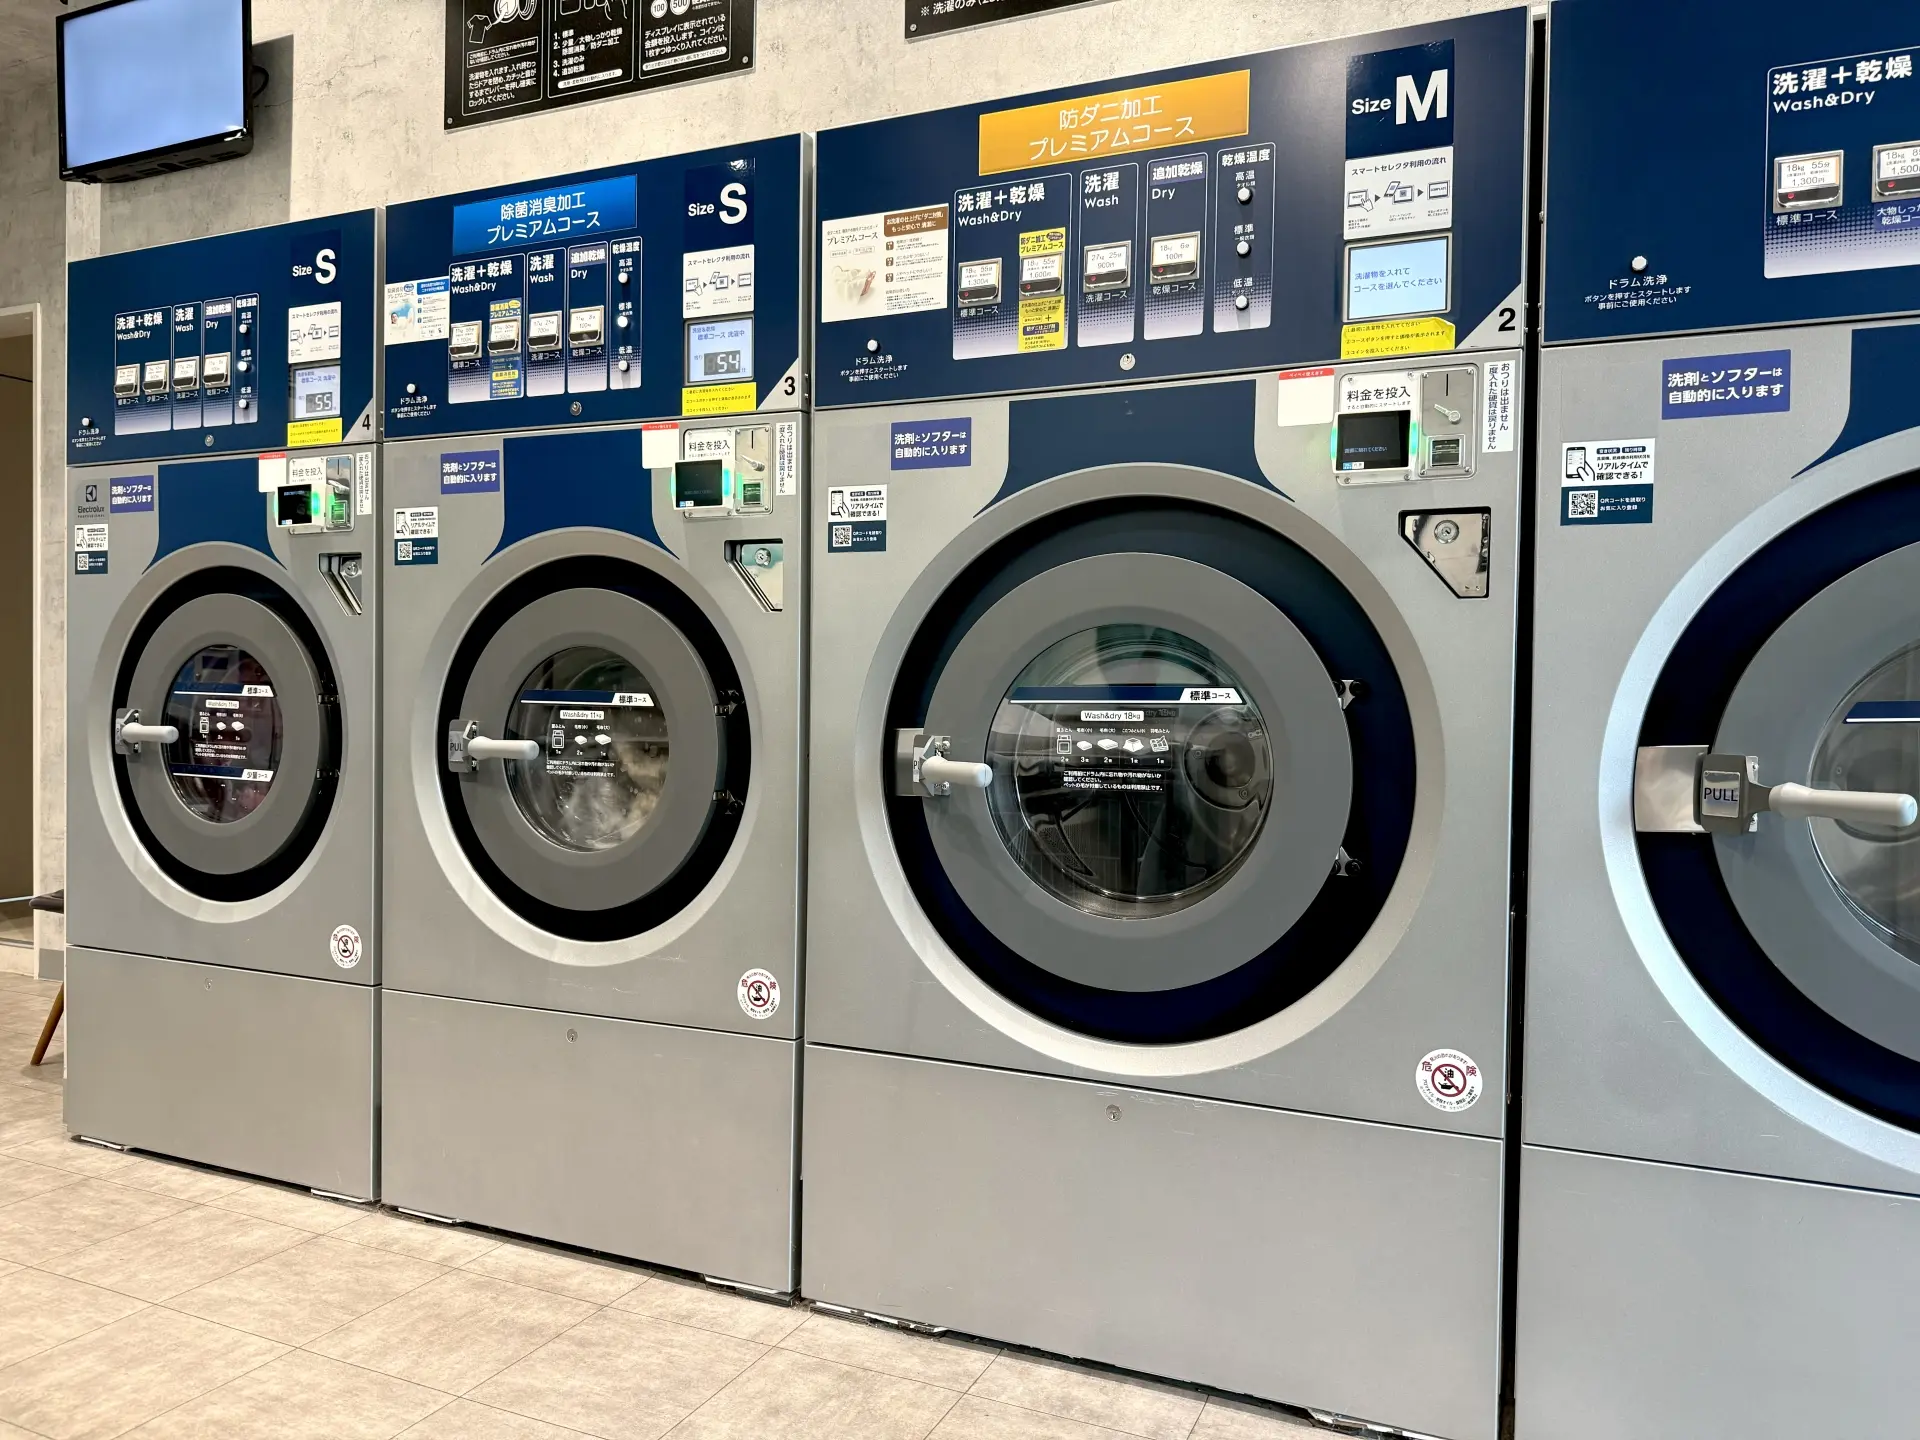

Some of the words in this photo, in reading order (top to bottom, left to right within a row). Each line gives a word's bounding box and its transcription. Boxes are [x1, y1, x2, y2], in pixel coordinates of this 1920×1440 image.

[654, 4, 664, 12] 100
[645, 14, 726, 39] ディスプレイに表示されている
[645, 24, 724, 49] 金額を投入します。コインは
[646, 34, 727, 58] 1枚ずつゆっくり入れてください。
[562, 55, 584, 66] 洗濯のみ
[469, 62, 536, 81] 洗濯物を入れます。入れ終わっ
[1773, 55, 1912, 95] 洗濯＋乾燥
[469, 68, 536, 90] たらドアを閉め、カチッと音が
[469, 78, 536, 98] するまでレバーを押し確実に
[469, 92, 515, 107] ロックしてください。
[1352, 97, 1391, 115] Size
[1395, 68, 1448, 125] M
[1773, 91, 1875, 113] Wash&Dry
[1059, 95, 1162, 130] 防ダニ加工
[1028, 115, 1195, 161] プレミアムコース
[1222, 148, 1270, 167] 乾燥温度
[1152, 161, 1203, 181] 追加乾燥
[1352, 157, 1446, 176] スマートセレクタ利用の流れ
[1787, 164, 1805, 172] 18kg
[1084, 171, 1120, 194] 洗濯
[1235, 169, 1255, 182] 高温
[1792, 176, 1824, 187] 1,300円
[958, 182, 1045, 213] 洗濯＋乾燥
[1152, 188, 1176, 200] Dry
[501, 192, 586, 221] 除菌消臭加工
[688, 203, 714, 216] Size
[719, 182, 747, 224] S
[1084, 195, 1119, 209] Wash
[958, 210, 1022, 227] Wash&Dry
[1776, 210, 1837, 226] 標準コース
[487, 211, 600, 244] プレミアムコース
[1234, 224, 1254, 235] 標準
[827, 232, 878, 246] プレミアムコース
[1020, 234, 1045, 245] 防ダニ加工
[612, 241, 640, 255] 乾燥温度
[1020, 241, 1064, 253] プレミアムコース
[530, 254, 554, 272] 洗濯
[571, 248, 605, 265] 追加乾燥
[619, 258, 632, 267] 高温
[688, 253, 750, 266] スマートセレクタ利用の流れ
[292, 265, 312, 277] Size
[315, 248, 336, 284] S
[451, 259, 512, 282] 洗濯＋乾燥
[530, 274, 554, 284] Wash
[571, 269, 587, 280] Dry
[1355, 267, 1410, 280] 洗濯物を入れて
[451, 281, 496, 294] Wash&Dry
[1153, 282, 1196, 295] 乾燥コース
[1233, 277, 1253, 288] 低温
[1354, 277, 1443, 292] コースを選んでください
[1609, 274, 1667, 289] ドラム洗浄
[1086, 290, 1127, 304] 洗濯コース
[1585, 286, 1691, 302] ボタンを押すとスタートします
[206, 302, 232, 316] 追加乾燥
[619, 302, 632, 311] 標準
[1598, 297, 1676, 310] 事前にご使用ください
[176, 307, 194, 322] 洗濯
[490, 309, 521, 318] プレミアムコース
[960, 306, 999, 318] 標準コース
[206, 320, 218, 329] Dry
[1498, 307, 1516, 332] 2
[176, 323, 193, 332] Wash
[117, 330, 151, 341] Wash&Dry
[531, 351, 560, 361] 洗濯コース
[572, 346, 602, 356] 乾燥コース
[619, 346, 633, 354] 低温
[453, 360, 480, 369] 標準コース
[717, 354, 740, 372] 54
[855, 354, 892, 366] ドラム洗浄
[840, 364, 908, 376] ボタンを押すとスタートします
[849, 373, 899, 382] 事前にご使用ください
[1668, 367, 1783, 388] 洗剤とソフターは
[784, 376, 796, 395] 3
[400, 396, 428, 405] ドラム洗浄
[1347, 386, 1411, 402] 料金を投入
[1500, 363, 1510, 431] おつりは出ません
[1668, 383, 1784, 404] 自動的に入ります
[315, 394, 332, 411] 55
[1488, 364, 1498, 450] 一度入れた硬貨は戻りません
[362, 414, 371, 430] 4
[894, 431, 966, 445] 洗剤とソフターは
[689, 440, 731, 451] 料金を投入
[895, 444, 967, 458] 自動的に入ります
[443, 461, 496, 473] 洗剤とソフターは
[1597, 461, 1648, 470] リアルタイムで
[443, 473, 497, 484] 自動的に入ります
[112, 494, 152, 505] 自動的に入ります
[619, 695, 646, 704] 標準コース
[1190, 690, 1231, 701] 標準コース
[1704, 787, 1738, 802] PULL
